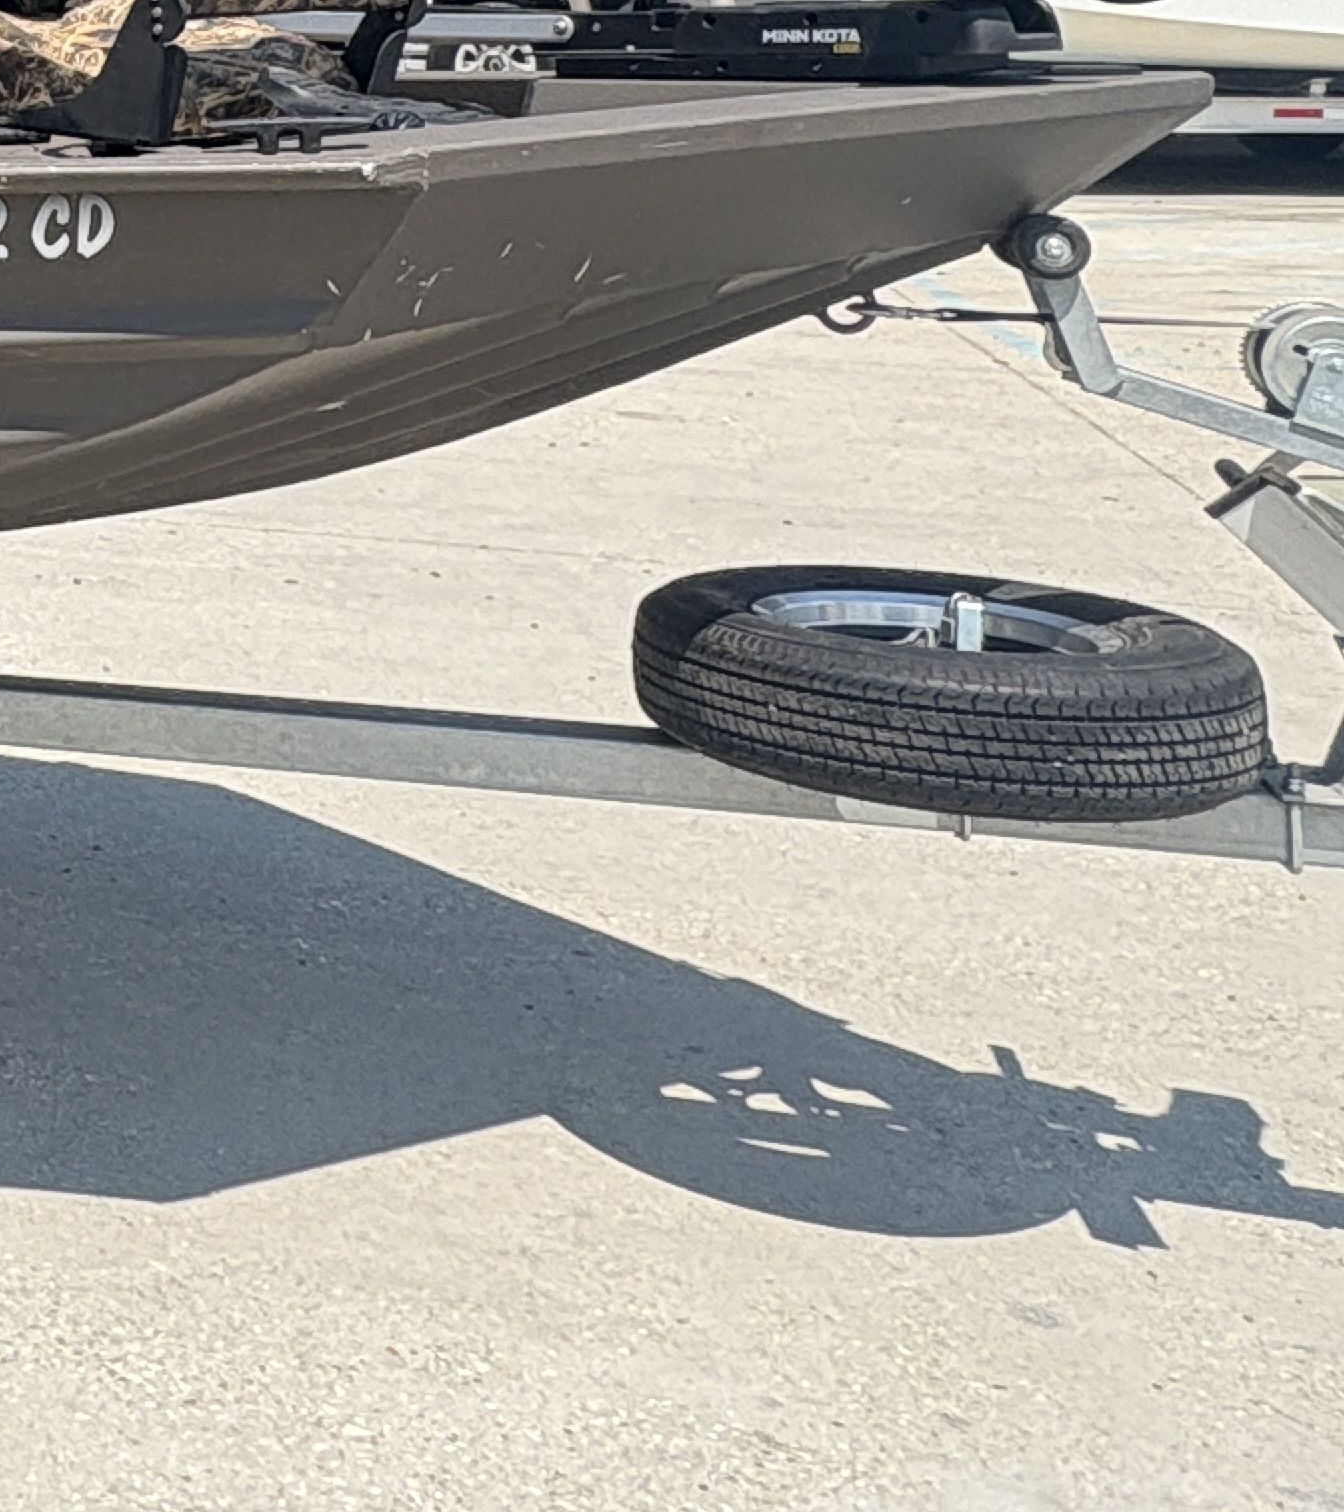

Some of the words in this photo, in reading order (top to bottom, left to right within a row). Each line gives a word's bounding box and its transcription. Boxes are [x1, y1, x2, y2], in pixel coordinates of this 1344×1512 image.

[762, 28, 810, 44] MINN
[812, 28, 861, 44] KOTA
[30, 192, 115, 260] CD
